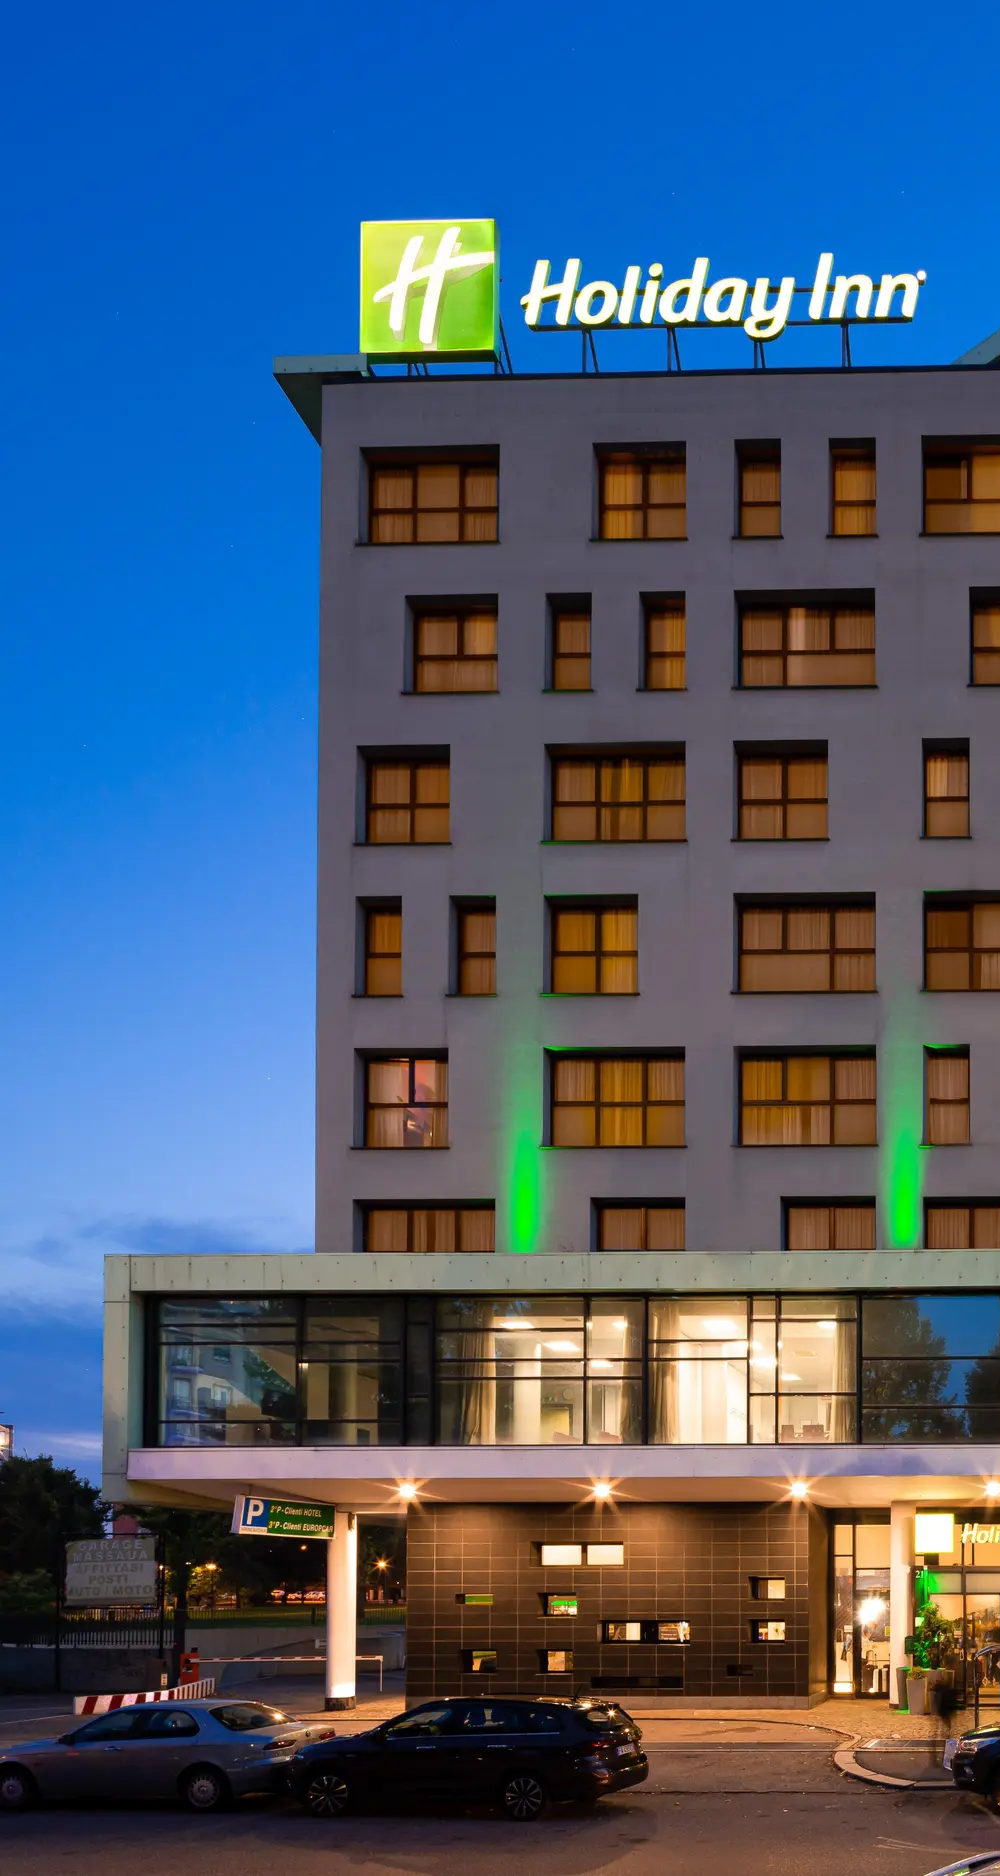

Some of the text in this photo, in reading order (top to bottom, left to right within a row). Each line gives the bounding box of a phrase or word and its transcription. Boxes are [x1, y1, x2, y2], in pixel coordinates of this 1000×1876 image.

[520, 257, 793, 341] Holiday
[247, 1500, 264, 1525] P
[303, 1509, 322, 1517] HOTEL
[302, 1523, 334, 1533] EUROPCAR
[79, 1540, 142, 1550] GARAGE
[75, 1562, 144, 1574] AFFITTASI
[89, 1574, 128, 1585] POSTI
[68, 1585, 101, 1597] AUTO
[112, 1584, 153, 1596] MOTO
